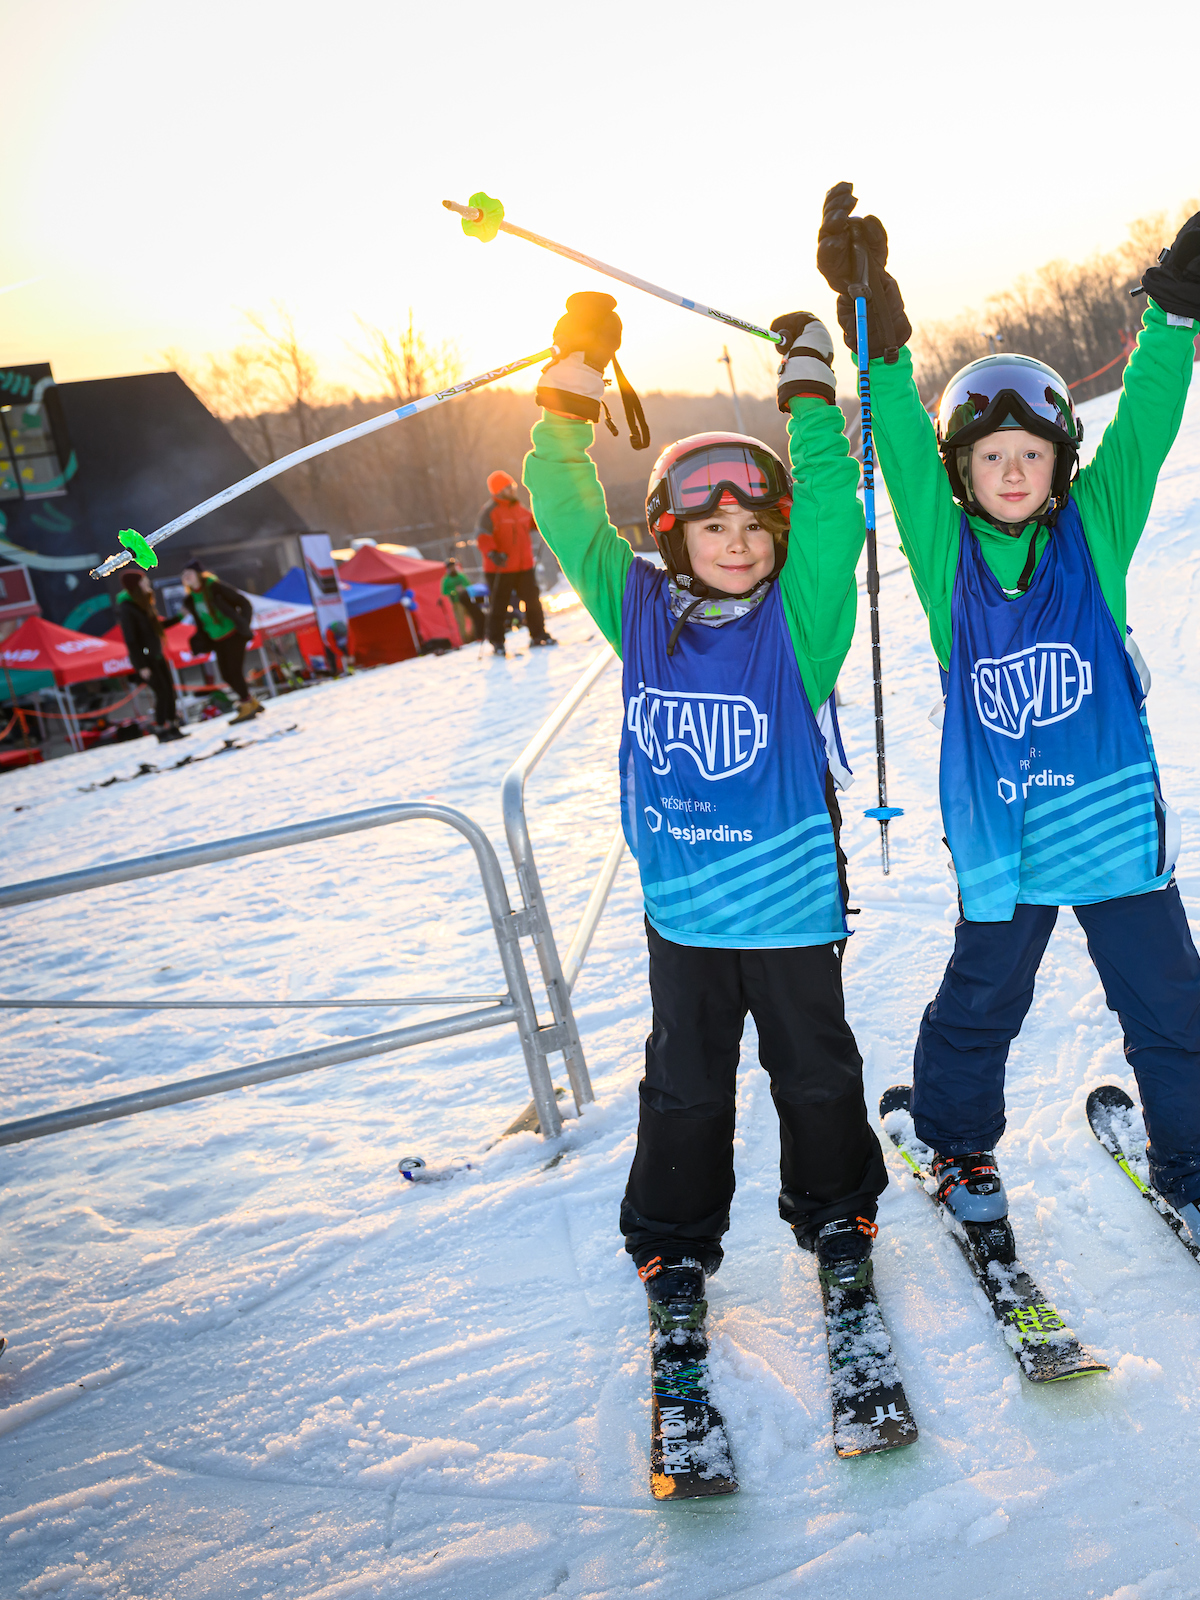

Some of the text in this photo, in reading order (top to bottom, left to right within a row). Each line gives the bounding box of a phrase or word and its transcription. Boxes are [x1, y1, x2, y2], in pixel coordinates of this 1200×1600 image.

[708, 307, 769, 336] KERMA
[434, 359, 533, 401] KERMA
[980, 651, 1077, 731] SKITVIE
[694, 801, 711, 813] PAR
[660, 1405, 691, 1475] FACTON
